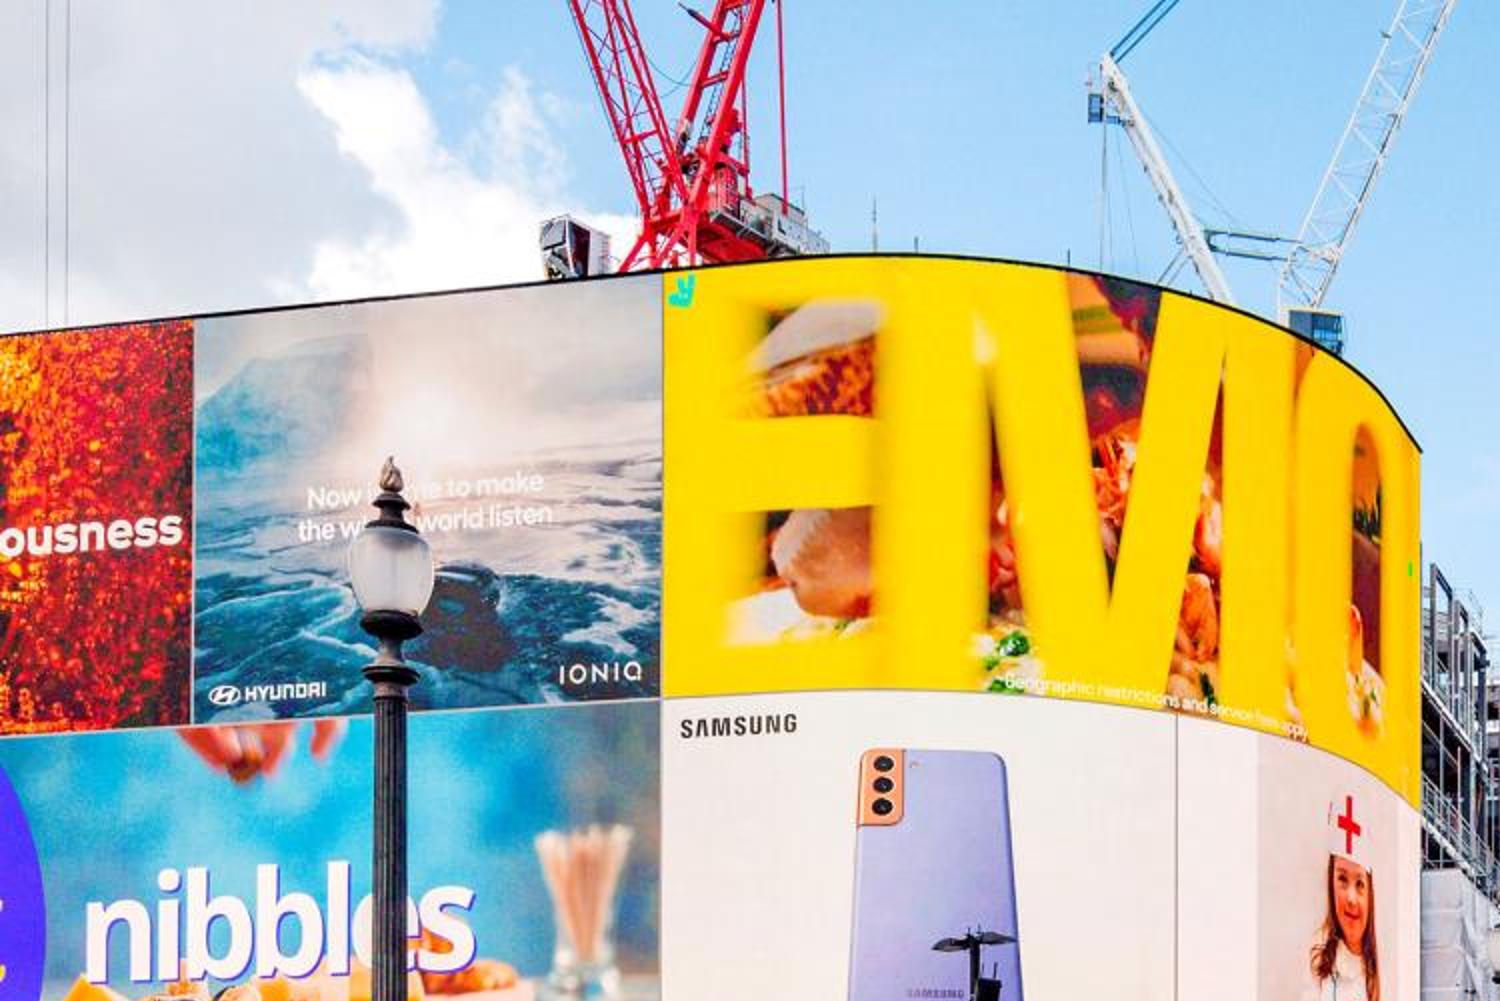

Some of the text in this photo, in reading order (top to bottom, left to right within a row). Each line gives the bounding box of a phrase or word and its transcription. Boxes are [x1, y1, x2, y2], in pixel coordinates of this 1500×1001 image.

[307, 488, 362, 510] Now
[449, 479, 470, 499] to
[478, 472, 545, 495] make
[0, 515, 183, 558] ousness
[298, 520, 335, 542] the
[417, 509, 483, 533] world
[489, 505, 552, 527] listen
[559, 661, 643, 685] IONIQ
[244, 681, 327, 702] HYUNDAI
[1182, 695, 1209, 713] and
[680, 713, 798, 739] SAMSUNG
